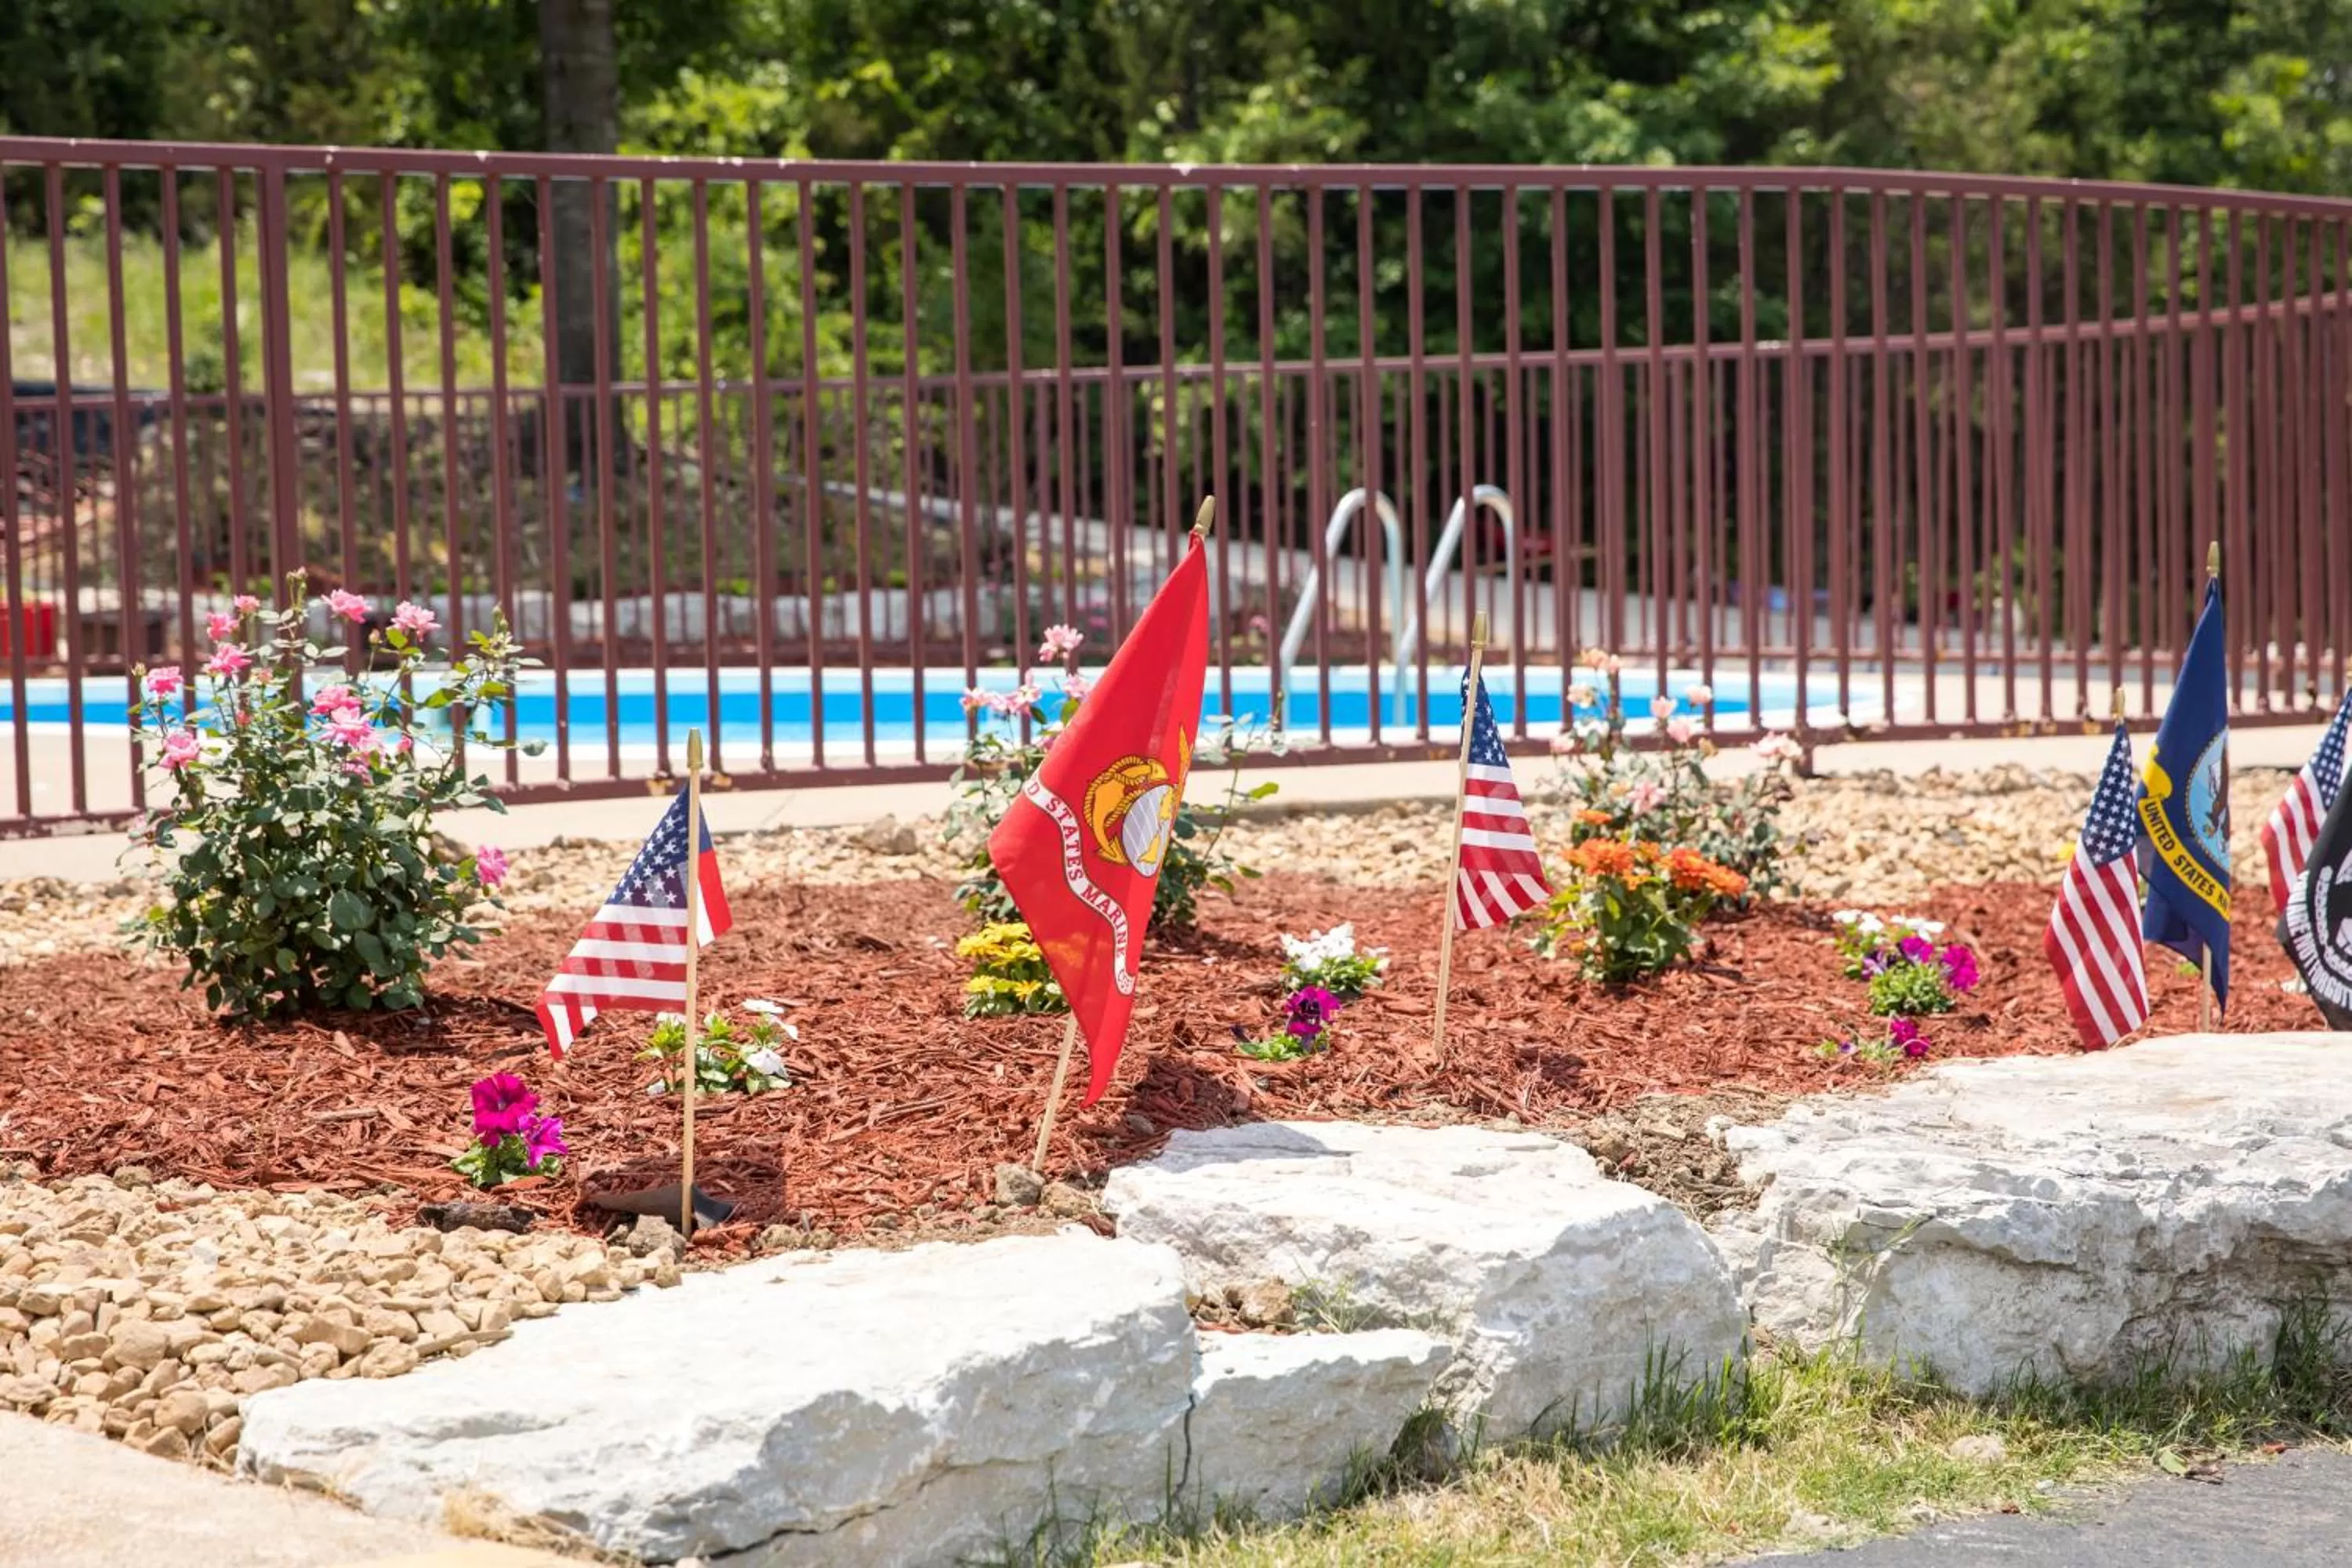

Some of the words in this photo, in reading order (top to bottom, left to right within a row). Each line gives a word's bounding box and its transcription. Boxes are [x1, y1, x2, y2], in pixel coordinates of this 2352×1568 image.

[1045, 797, 1083, 881] STATES
[1081, 885, 1127, 958] MARINE
[2144, 801, 2176, 851] UNITED
[2173, 854, 2216, 896] STATES
[2293, 931, 2319, 970] NOT
